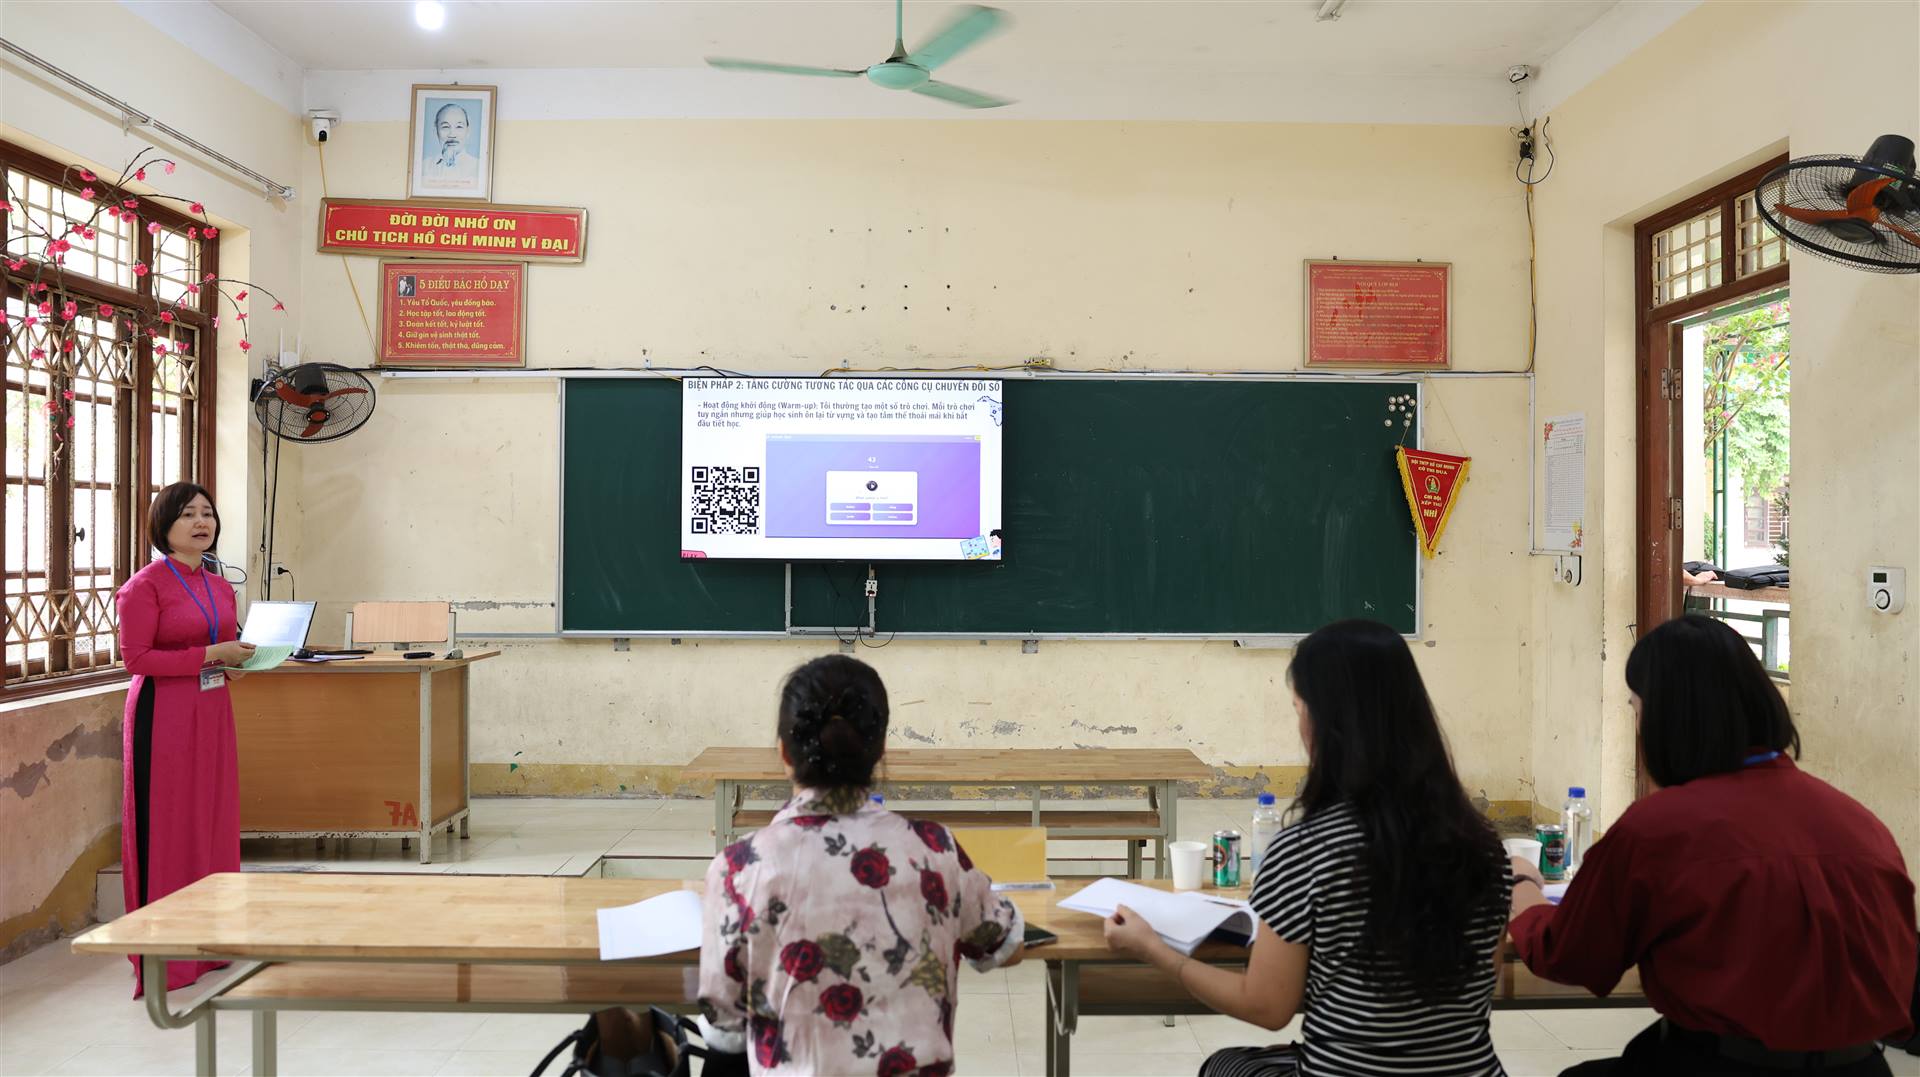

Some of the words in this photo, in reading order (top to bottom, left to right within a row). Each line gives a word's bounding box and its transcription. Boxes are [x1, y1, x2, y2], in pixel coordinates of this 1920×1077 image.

[390, 212, 417, 226] ĐỜI
[422, 213, 449, 228] ĐỜI
[454, 215, 488, 229] NHỚ
[493, 217, 516, 230] ƠN
[335, 226, 368, 242] CHỦ
[373, 230, 408, 244] TỊCH
[414, 230, 435, 245] HỒ
[440, 233, 467, 246] CHÍ
[472, 234, 516, 248] MINH
[522, 235, 538, 249] VĨ
[541, 237, 569, 252] ĐẠI
[420, 279, 426, 289] 5
[429, 275, 451, 289] ĐIỀU
[453, 277, 473, 289] BÁC
[474, 275, 489, 289] HỒ
[490, 279, 510, 292] DẠY
[407, 298, 420, 306] Yêu
[451, 299, 463, 307] yêu
[457, 310, 475, 319] động
[688, 378, 708, 391] BIỆN
[711, 378, 734, 389] PHÁP
[736, 381, 744, 389] 2:
[772, 378, 803, 390] CƯỜNG
[806, 380, 836, 390] TƯƠNG
[839, 378, 854, 390] TÁC
[857, 381, 874, 391] QUA
[877, 379, 893, 390] CÁC
[896, 379, 919, 390] CÔNG
[921, 382, 933, 392] CỤ
[703, 401, 720, 410] Hoạt
[721, 400, 739, 410] động
[741, 401, 757, 409] khởi
[759, 401, 777, 410] động
[820, 401, 831, 410] Tôi
[832, 402, 860, 411] thường
[861, 402, 873, 411] tạo
[875, 402, 888, 411] một
[913, 402, 930, 410] chơi.
[960, 403, 975, 411] chơi
[698, 411, 709, 419] tuy
[731, 411, 754, 419] nhưng
[773, 411, 786, 420] học
[788, 411, 803, 419] sinh
[805, 411, 814, 419] ôn
[816, 411, 825, 421] lại
[837, 412, 855, 421] vựng
[857, 411, 865, 419] và
[867, 412, 878, 421] tạo
[943, 412, 954, 420] khi
[713, 420, 725, 428] tiết
[384, 800, 418, 827] 7A
